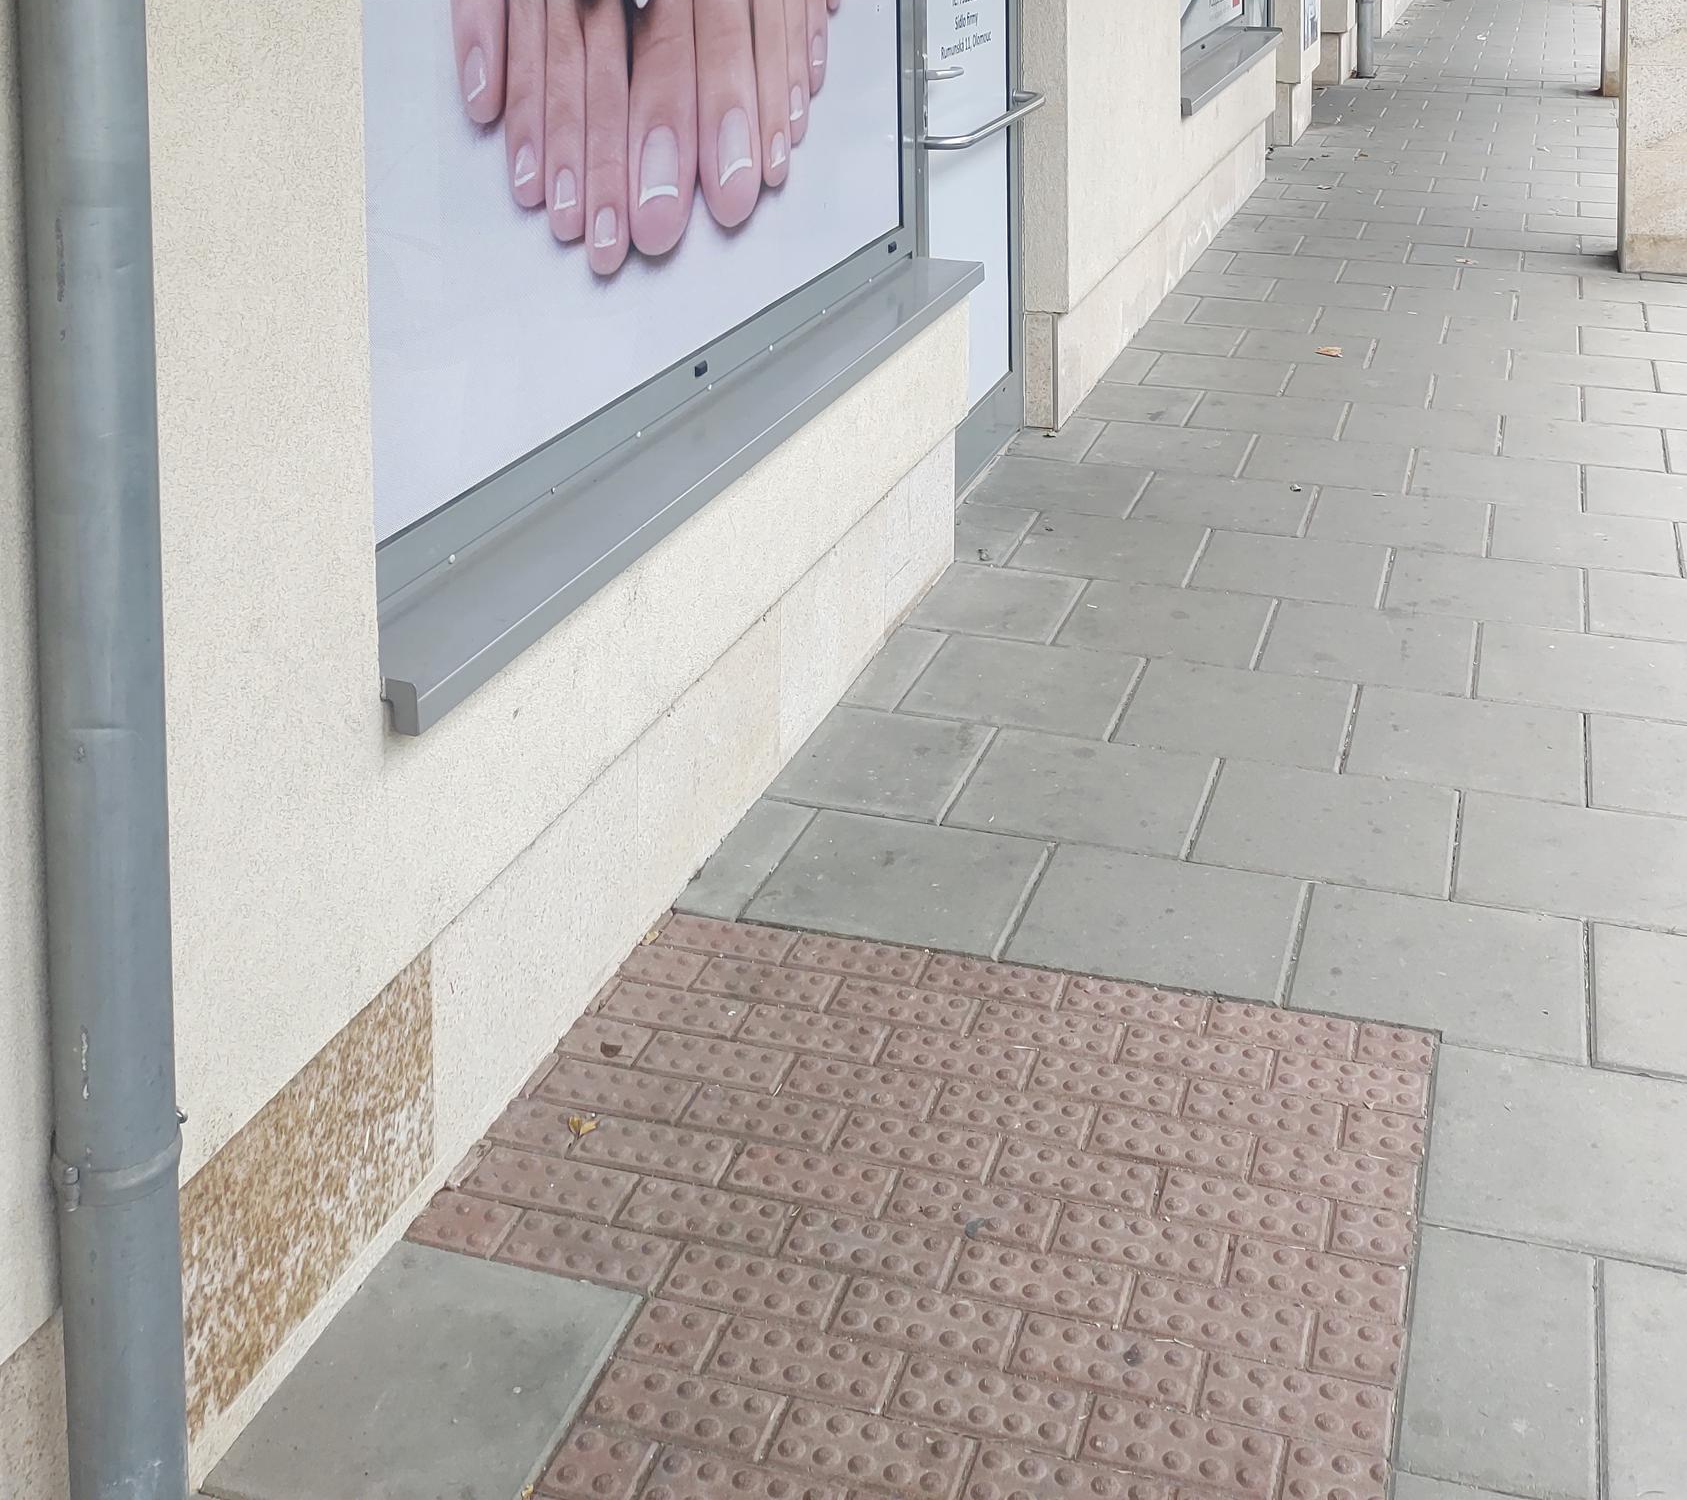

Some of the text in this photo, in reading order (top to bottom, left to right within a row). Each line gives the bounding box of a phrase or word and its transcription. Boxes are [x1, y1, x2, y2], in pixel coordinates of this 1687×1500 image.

[954, 12, 979, 31] Sídlo firmy
[941, 38, 964, 60] Rumunská
[972, 31, 991, 46] Olomouc
